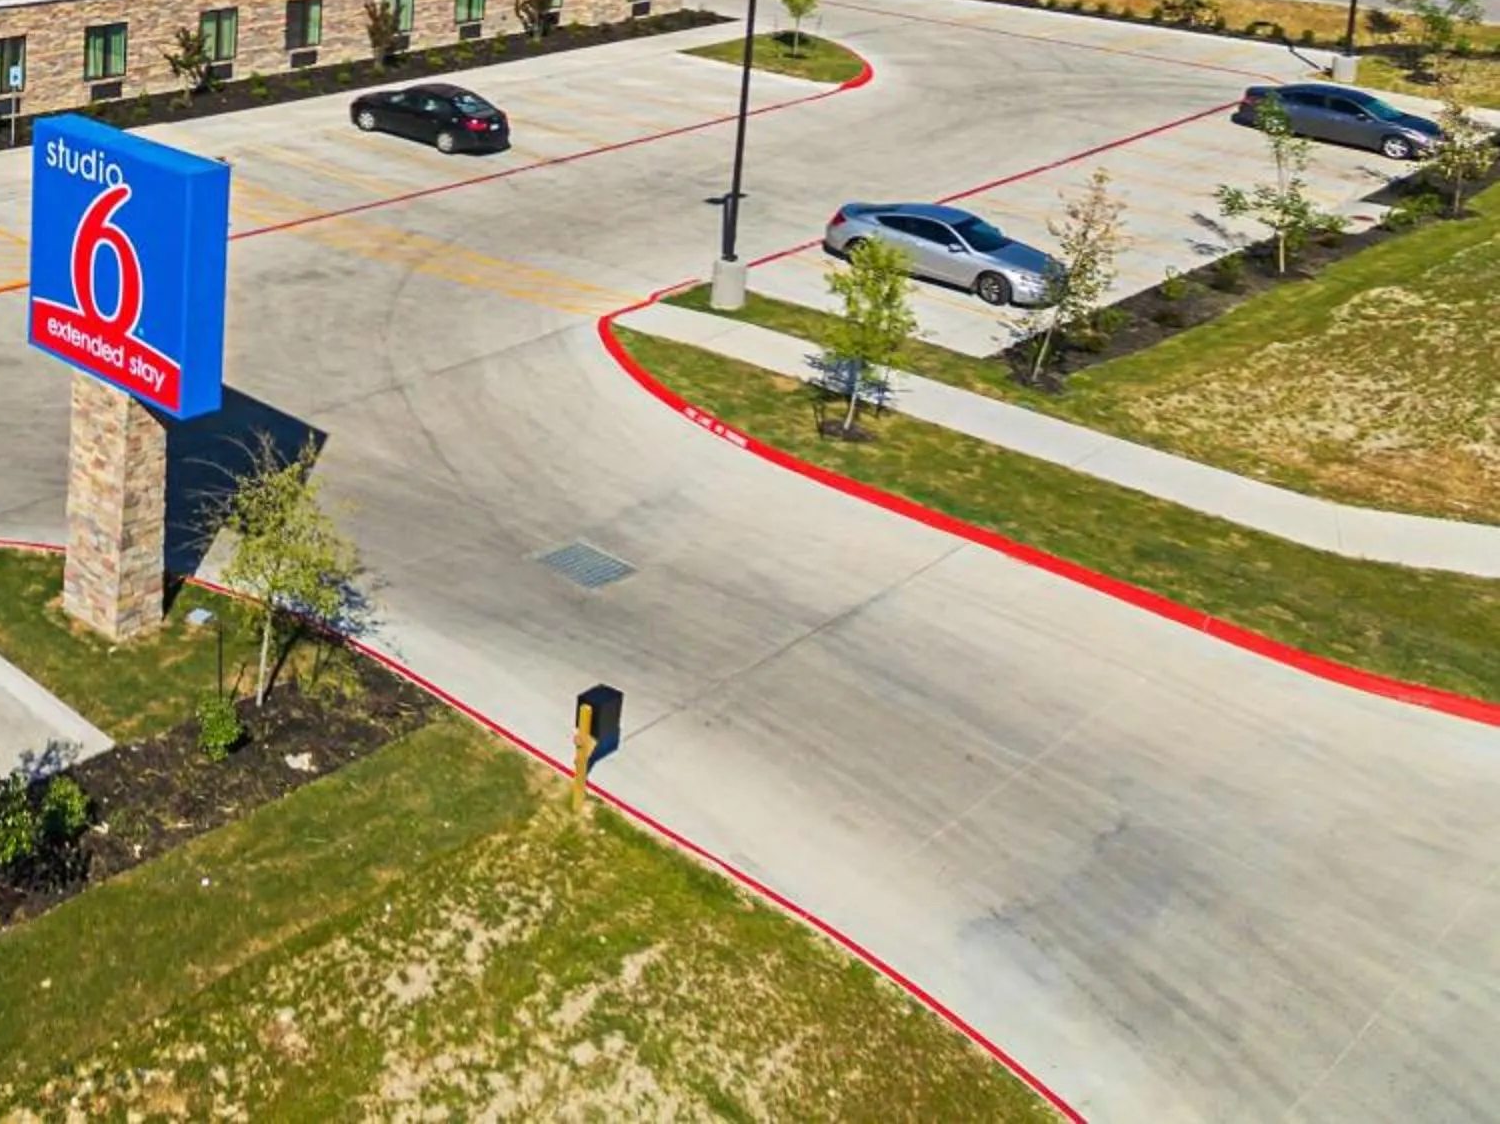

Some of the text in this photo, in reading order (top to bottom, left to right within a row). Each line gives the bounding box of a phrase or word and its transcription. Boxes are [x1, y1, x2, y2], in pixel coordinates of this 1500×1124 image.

[46, 137, 123, 187] studio
[71, 184, 144, 336] 6
[47, 316, 165, 393] extended stay
